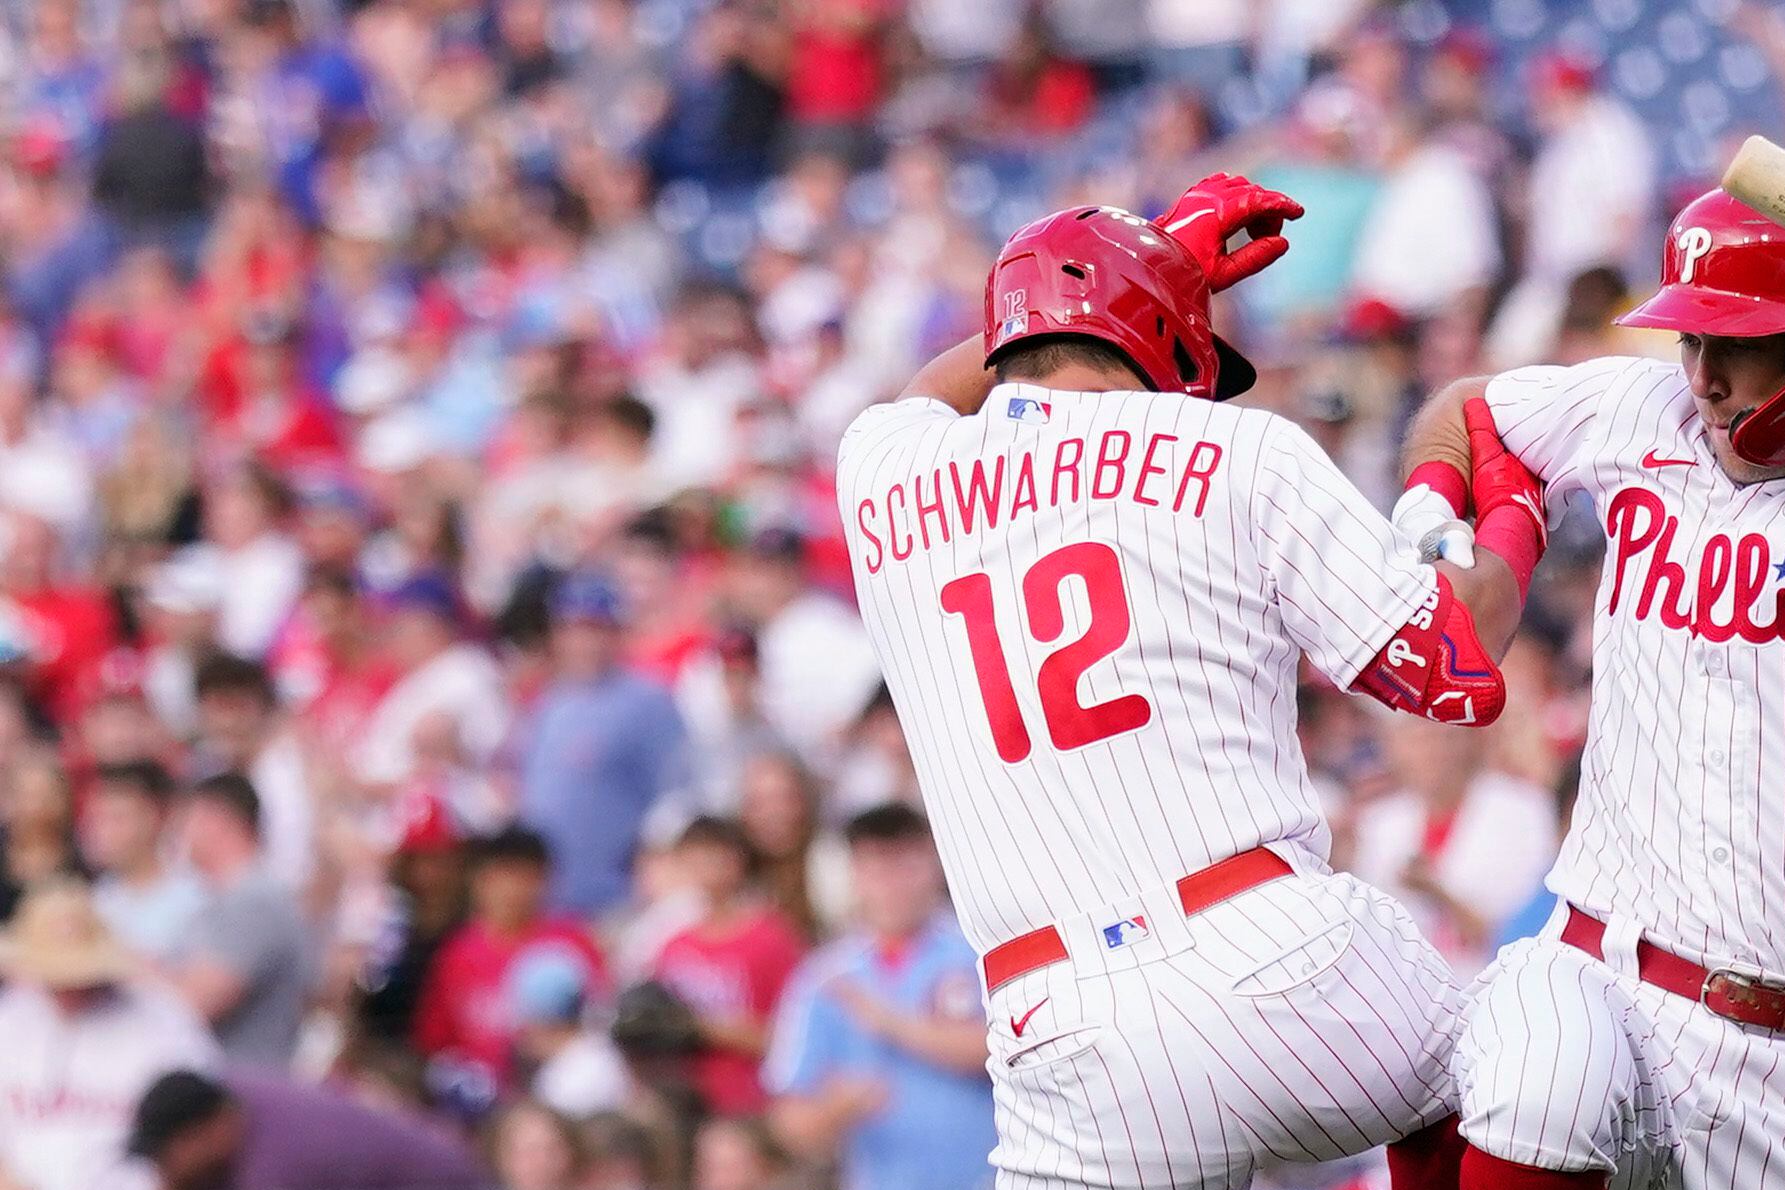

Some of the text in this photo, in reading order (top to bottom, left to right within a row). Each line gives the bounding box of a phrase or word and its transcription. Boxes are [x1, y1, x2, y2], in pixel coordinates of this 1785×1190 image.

[1004, 289, 1026, 319] 12
[1679, 227, 1712, 284] P
[858, 430, 1223, 574] SCHWARBER
[940, 541, 1151, 763] 12
